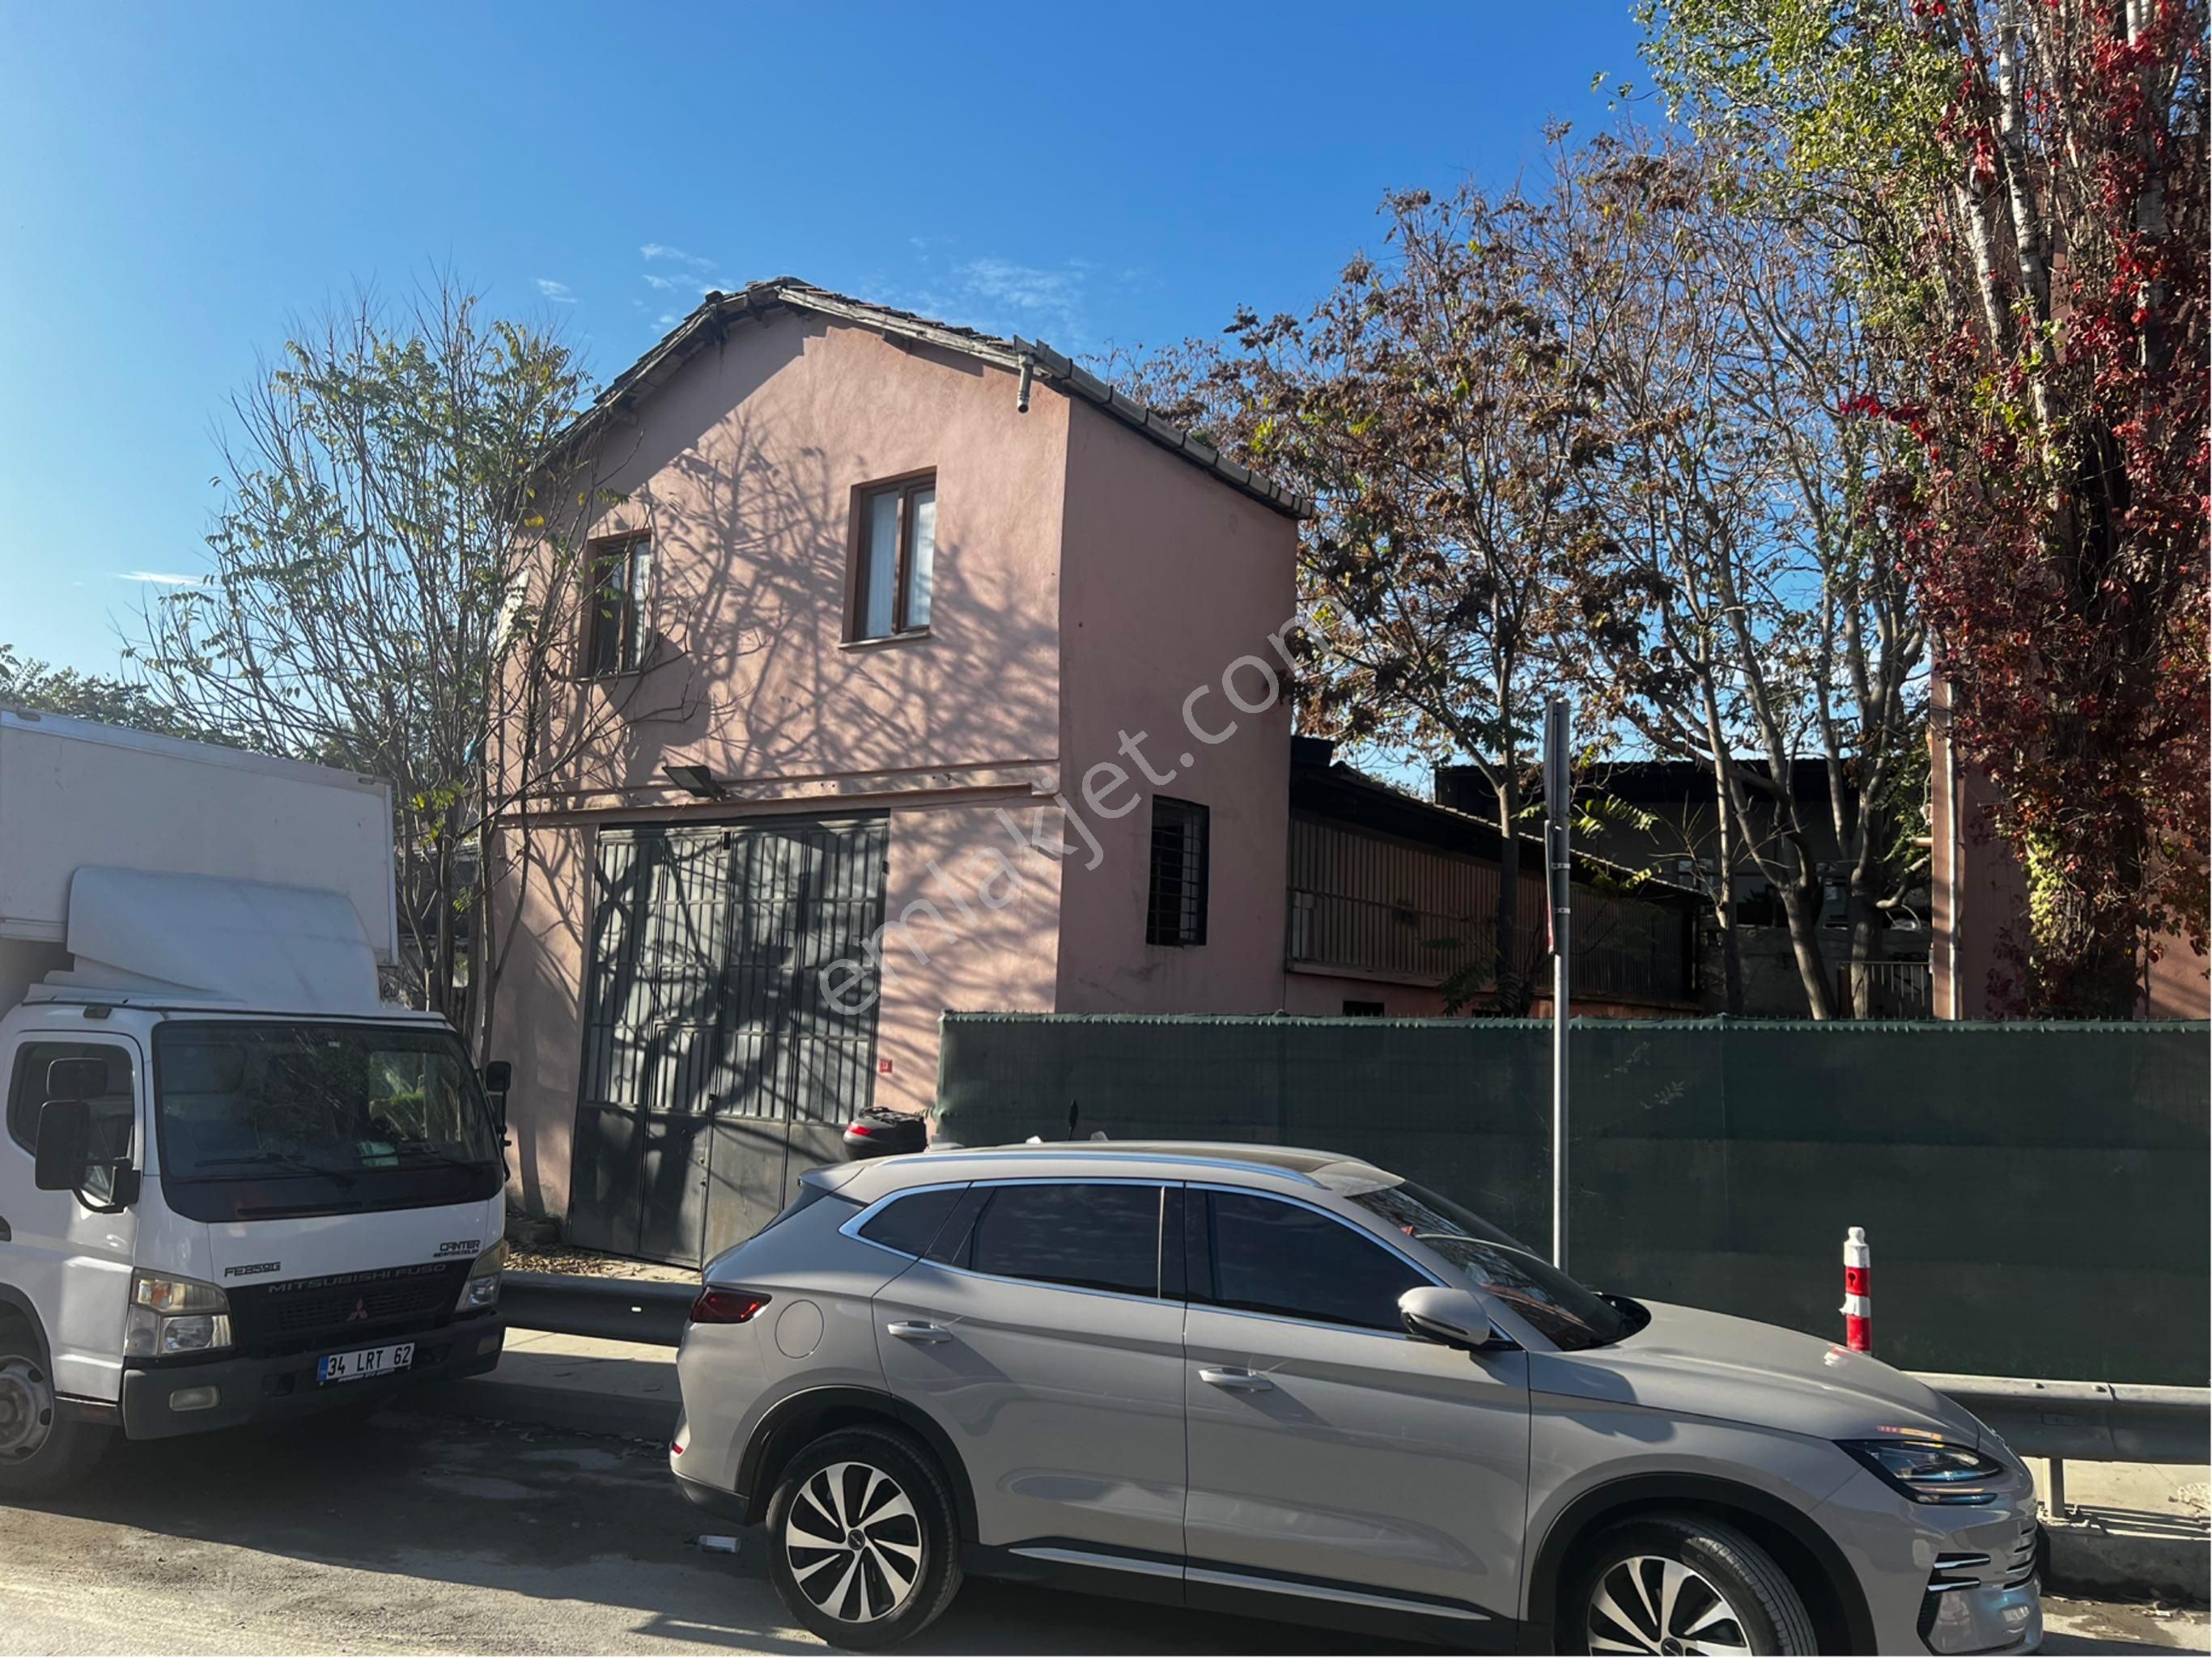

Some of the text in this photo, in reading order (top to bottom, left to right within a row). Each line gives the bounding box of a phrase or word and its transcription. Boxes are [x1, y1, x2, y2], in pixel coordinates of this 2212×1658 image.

[440, 1240, 480, 1251] CANTER
[269, 1264, 446, 1293] MITSUBISHI FUSO
[328, 1355, 346, 1376] 34
[356, 1350, 384, 1372] LRT
[393, 1346, 411, 1365] 62
